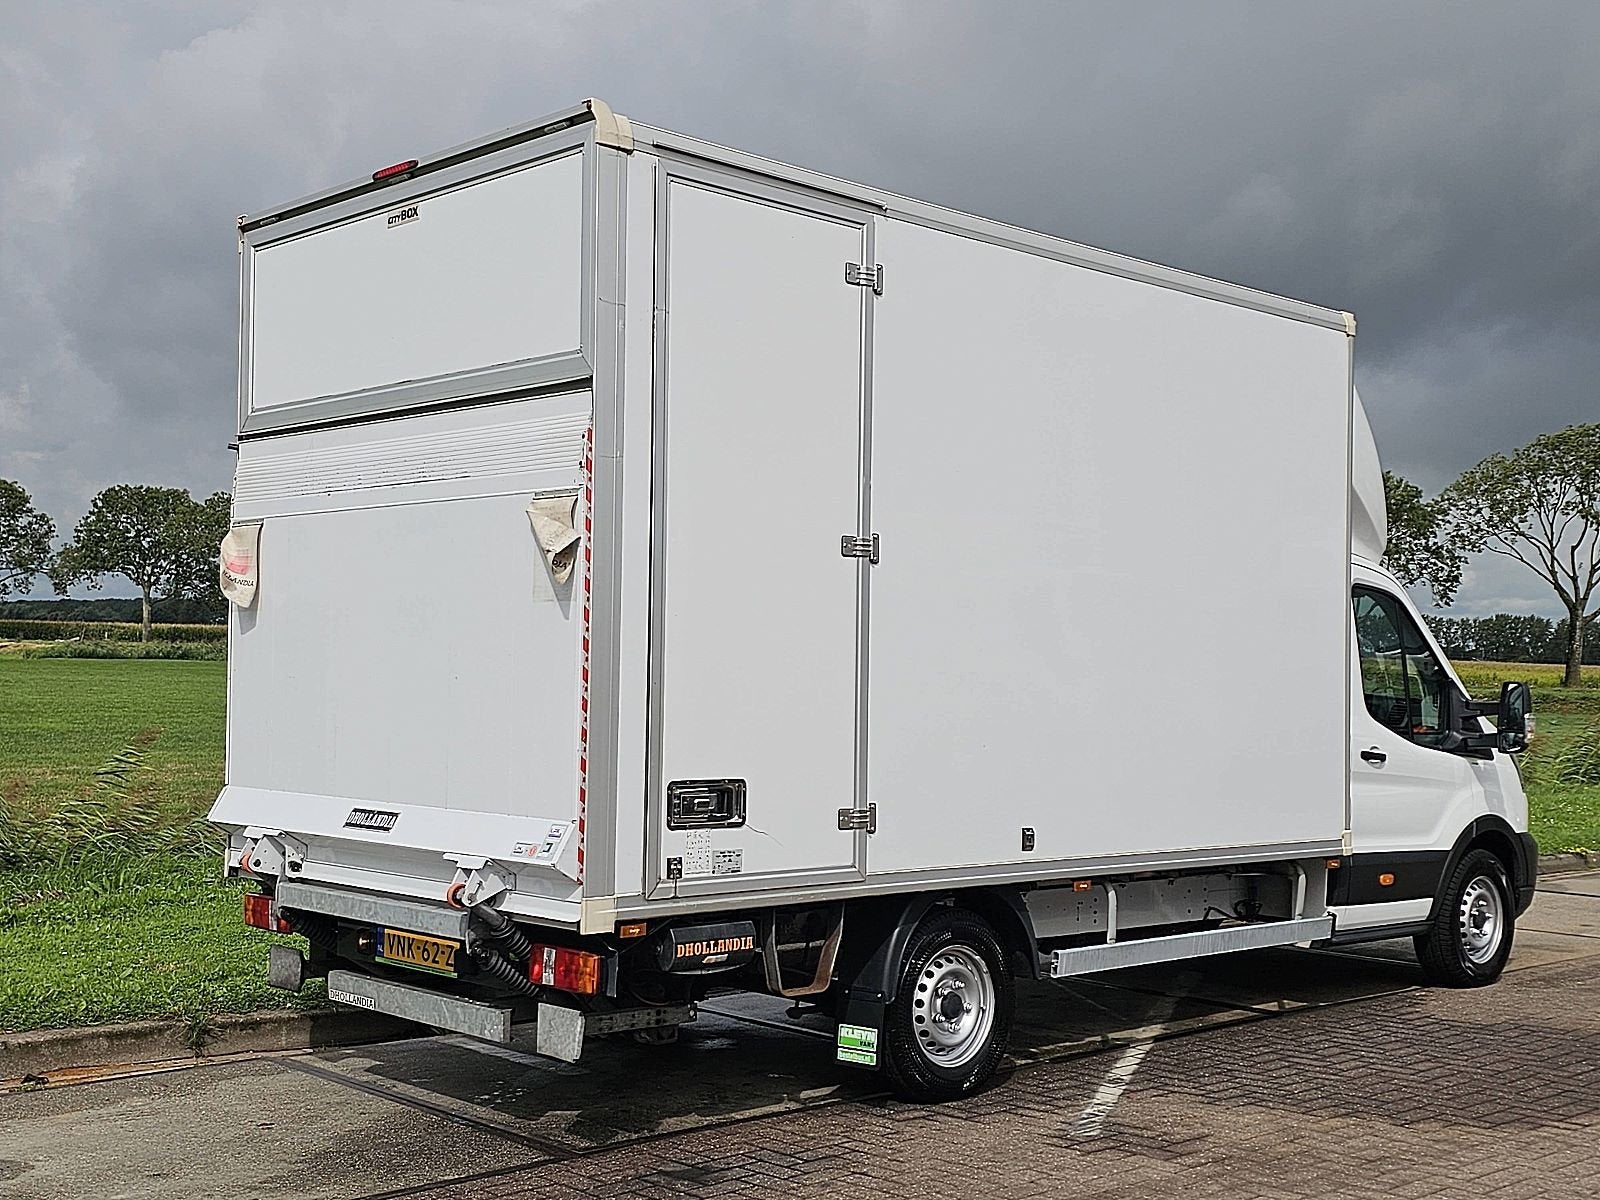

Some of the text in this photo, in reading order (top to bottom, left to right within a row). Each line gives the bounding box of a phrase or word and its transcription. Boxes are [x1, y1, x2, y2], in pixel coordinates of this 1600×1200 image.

[346, 811, 397, 828] DHOLLANDIA
[387, 932, 455, 968] VNK-62-Z
[676, 936, 754, 958] DHOLLANDIA
[329, 990, 374, 1009] DHOLLANDIA
